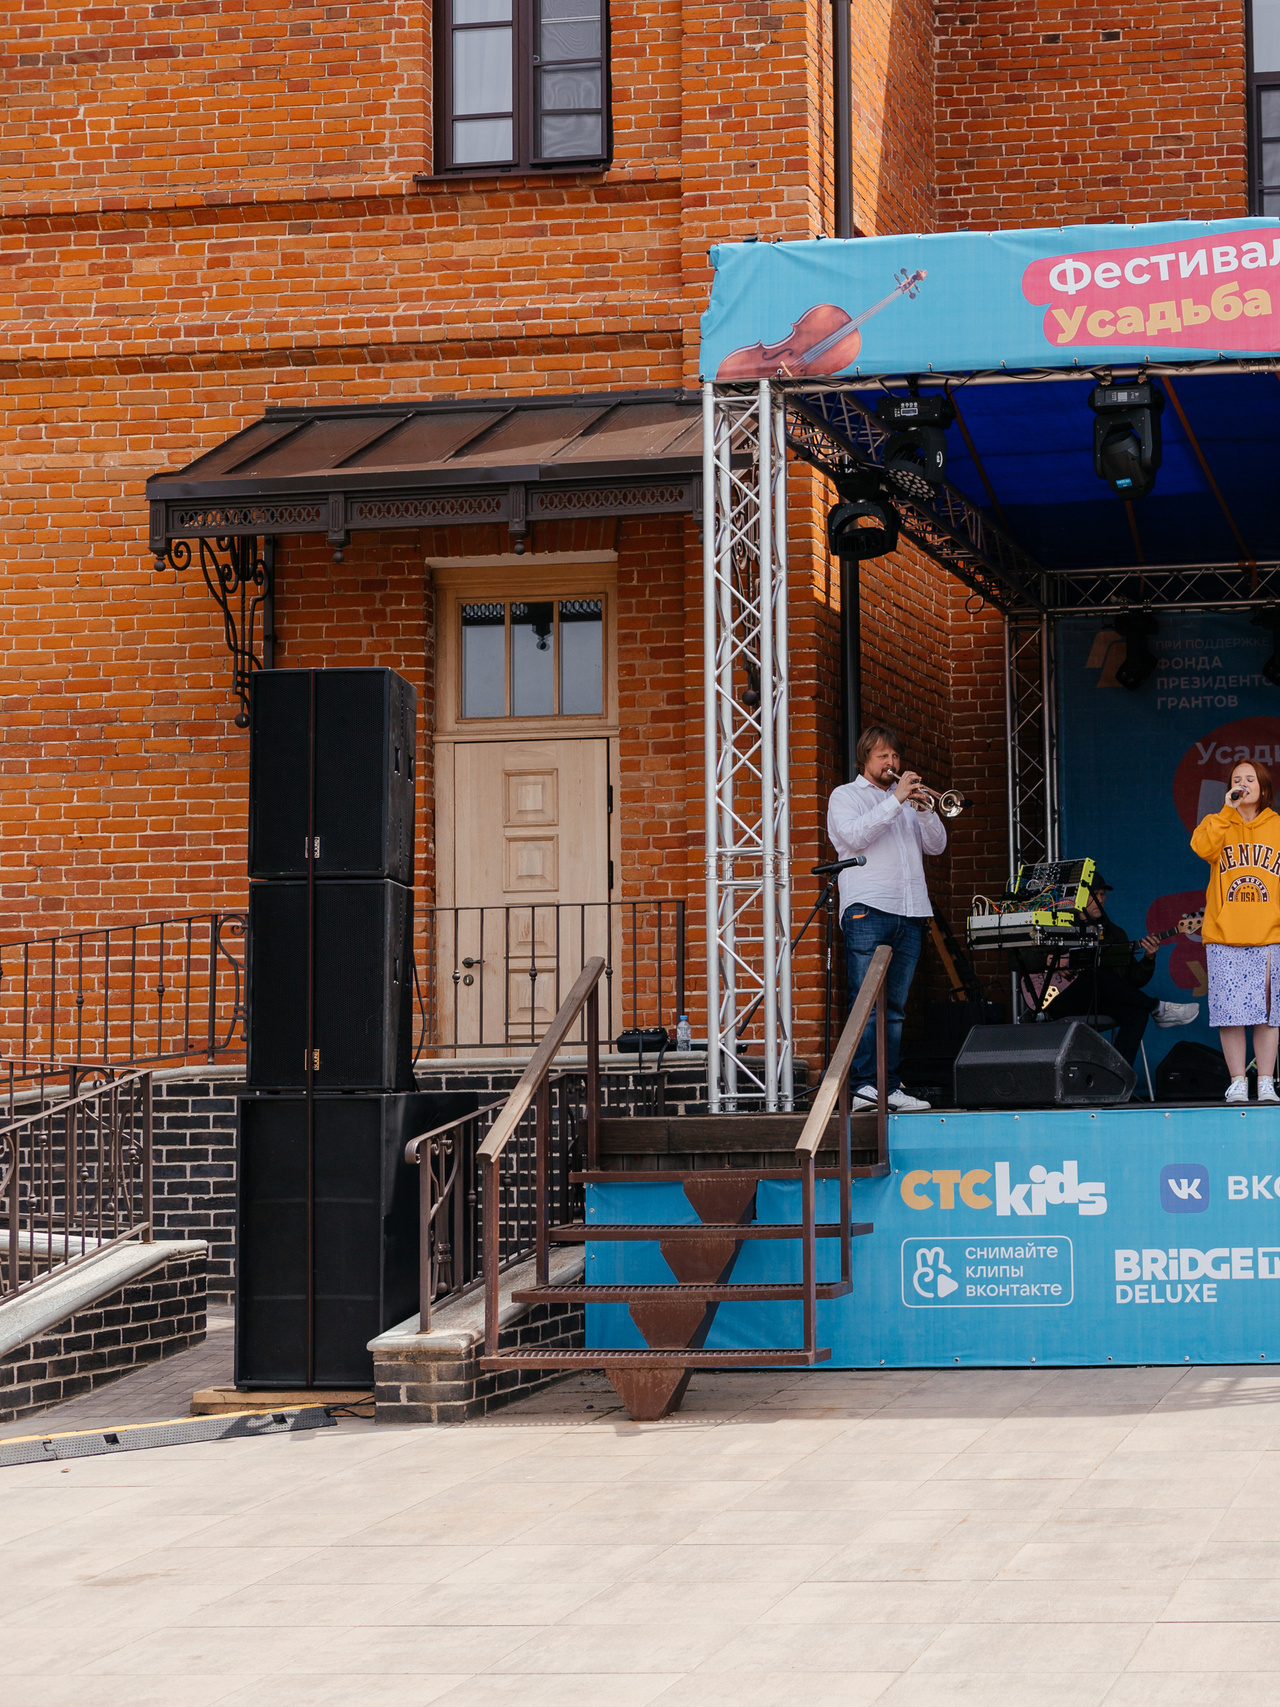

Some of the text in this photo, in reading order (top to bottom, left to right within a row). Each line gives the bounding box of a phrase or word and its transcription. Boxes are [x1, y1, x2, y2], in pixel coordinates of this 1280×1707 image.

[1051, 281, 1272, 343] Усадьба
[1155, 636, 1271, 650] ПРИ ПОДДЕРЖКЕ
[1156, 655, 1224, 671] ФОНДА
[1156, 694, 1239, 710] ГРАНТОВ
[1240, 892, 1255, 902] USA
[965, 1242, 1058, 1260] снимайте
[965, 1264, 1024, 1279] клипы
[965, 1282, 1062, 1298] вконтакте
[1115, 1283, 1218, 1304] DELUXE
